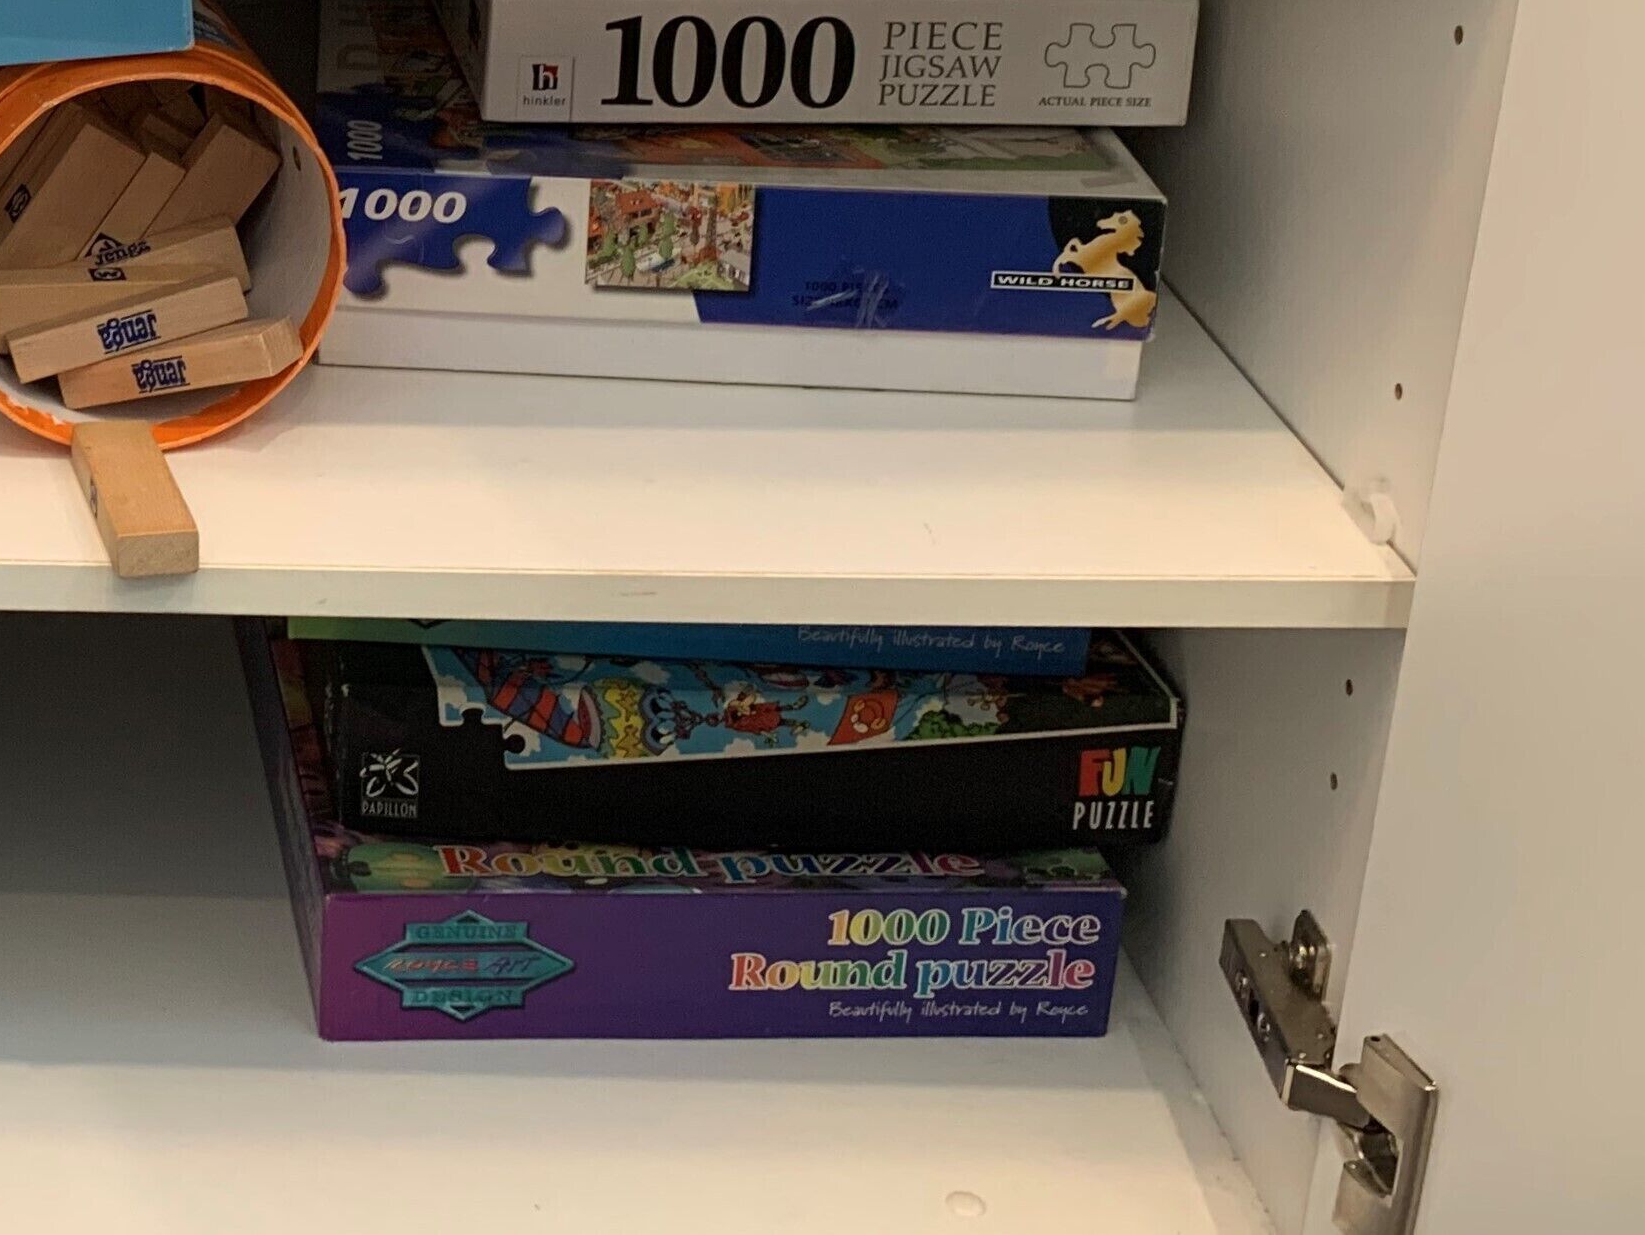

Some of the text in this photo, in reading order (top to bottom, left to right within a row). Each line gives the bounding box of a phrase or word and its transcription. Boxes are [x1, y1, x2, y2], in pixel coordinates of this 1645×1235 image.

[883, 21, 1004, 51] PIECE
[601, 14, 856, 109] 1000
[879, 54, 1003, 81] JIGSAW
[522, 93, 567, 108] hinkler
[877, 82, 997, 108] PUZZLE
[1038, 96, 1153, 108] ACTUAL PIECE SIZE
[347, 120, 383, 161] 1000
[339, 187, 468, 223] 1000
[996, 274, 1130, 290] WILD HORSE
[797, 625, 1065, 661] Beautifully illustrated by Royce
[1078, 746, 1162, 797] FUN
[360, 801, 418, 819] PAPILLON
[1072, 799, 1155, 831] PUZZLE
[433, 844, 987, 884] Round puzzle
[416, 924, 519, 941] GENUINE
[828, 905, 1102, 947] 1000 Piece
[728, 949, 1096, 1000] Round puzzle
[411, 988, 515, 1004] DESIGN
[828, 1000, 1089, 1024] Beautifully illustrated by Royce
